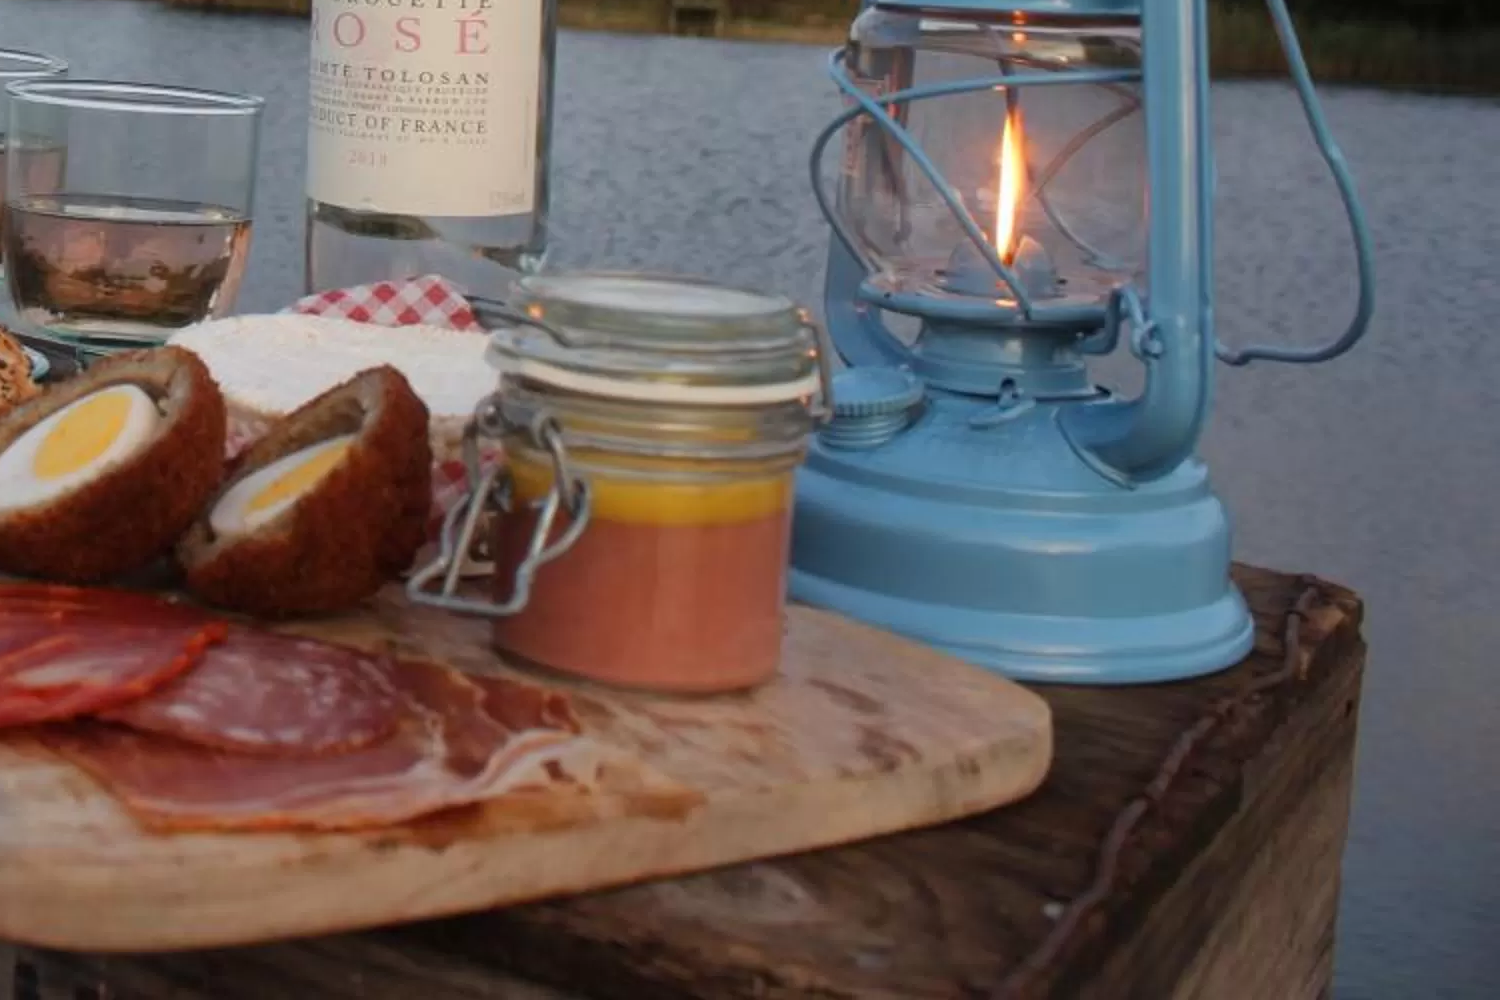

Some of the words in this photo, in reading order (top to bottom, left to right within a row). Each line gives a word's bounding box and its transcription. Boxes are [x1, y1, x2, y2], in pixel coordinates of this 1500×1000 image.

[363, 67, 489, 85] TOLOSAN
[365, 114, 391, 131] OF
[400, 119, 487, 135] FRANCE
